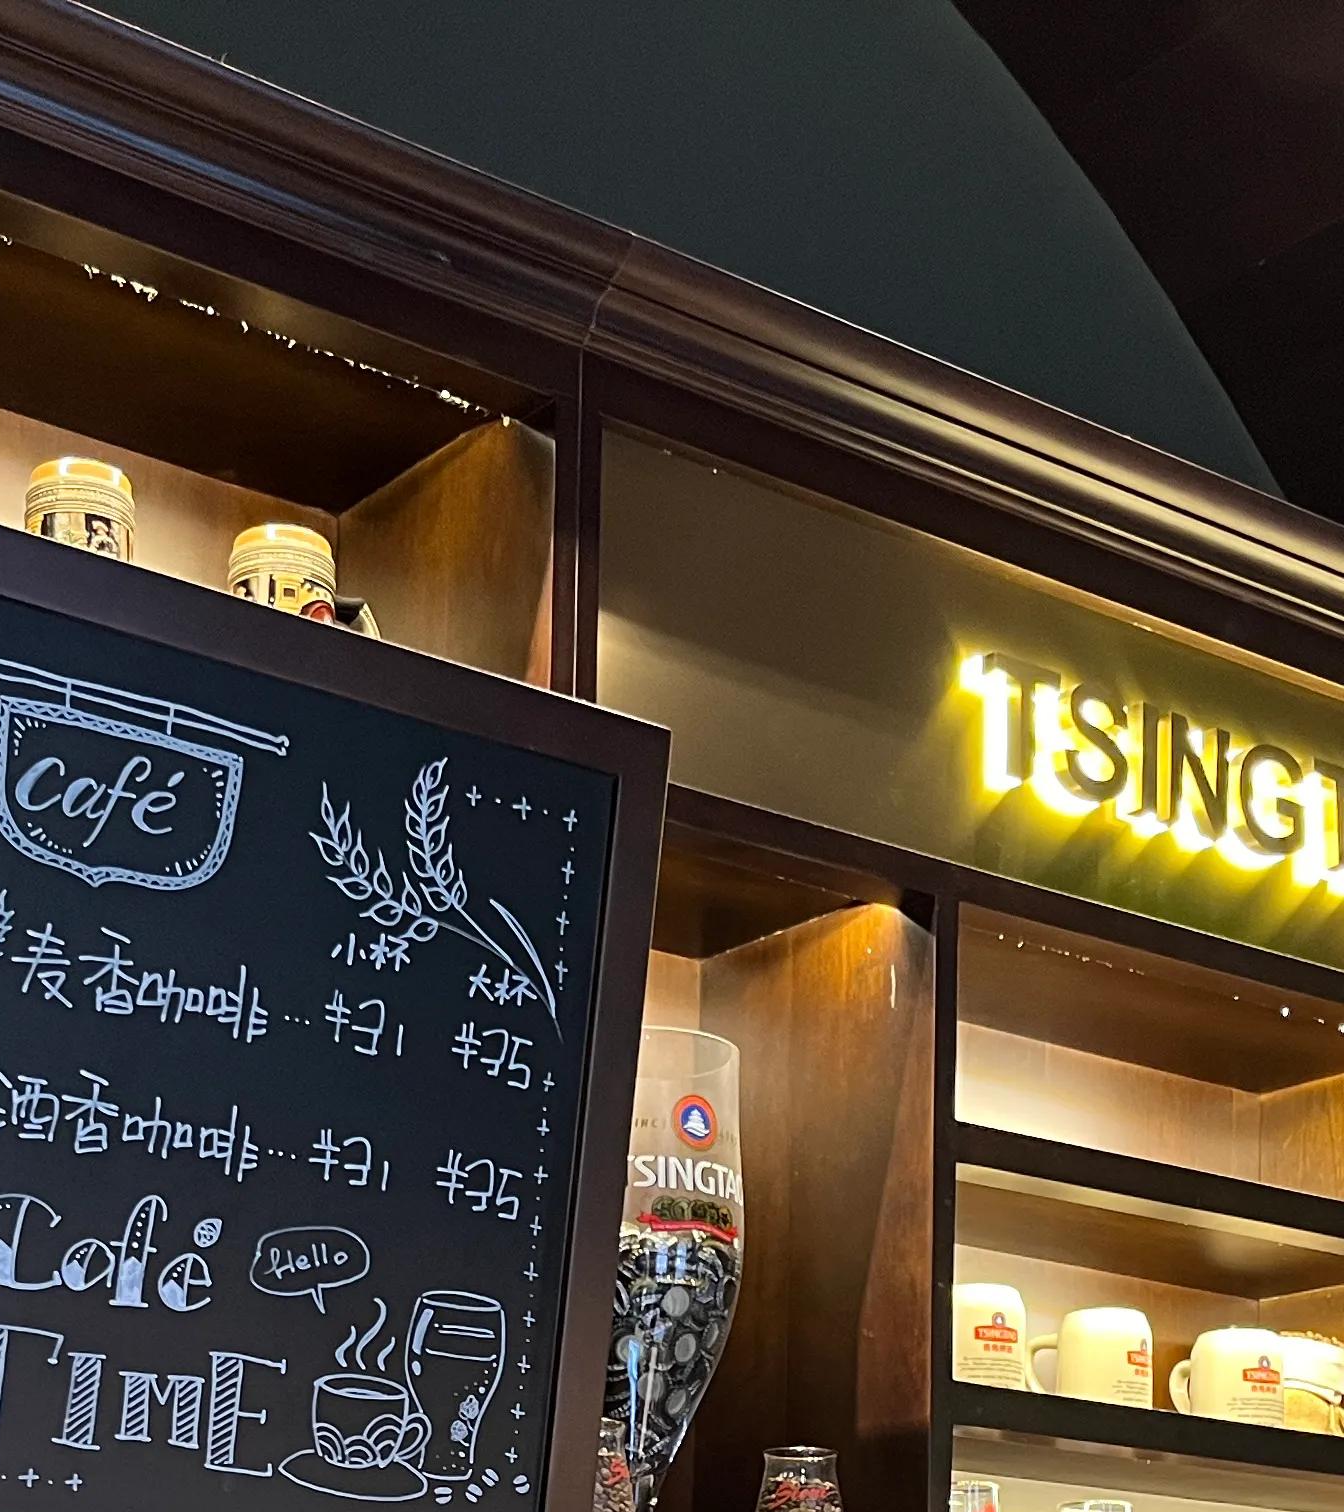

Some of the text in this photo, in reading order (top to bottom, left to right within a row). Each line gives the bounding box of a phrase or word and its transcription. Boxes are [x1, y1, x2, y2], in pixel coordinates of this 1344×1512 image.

[331, 931, 540, 1008] 小杯 大杯
[263, 1241, 352, 1282] Hello
